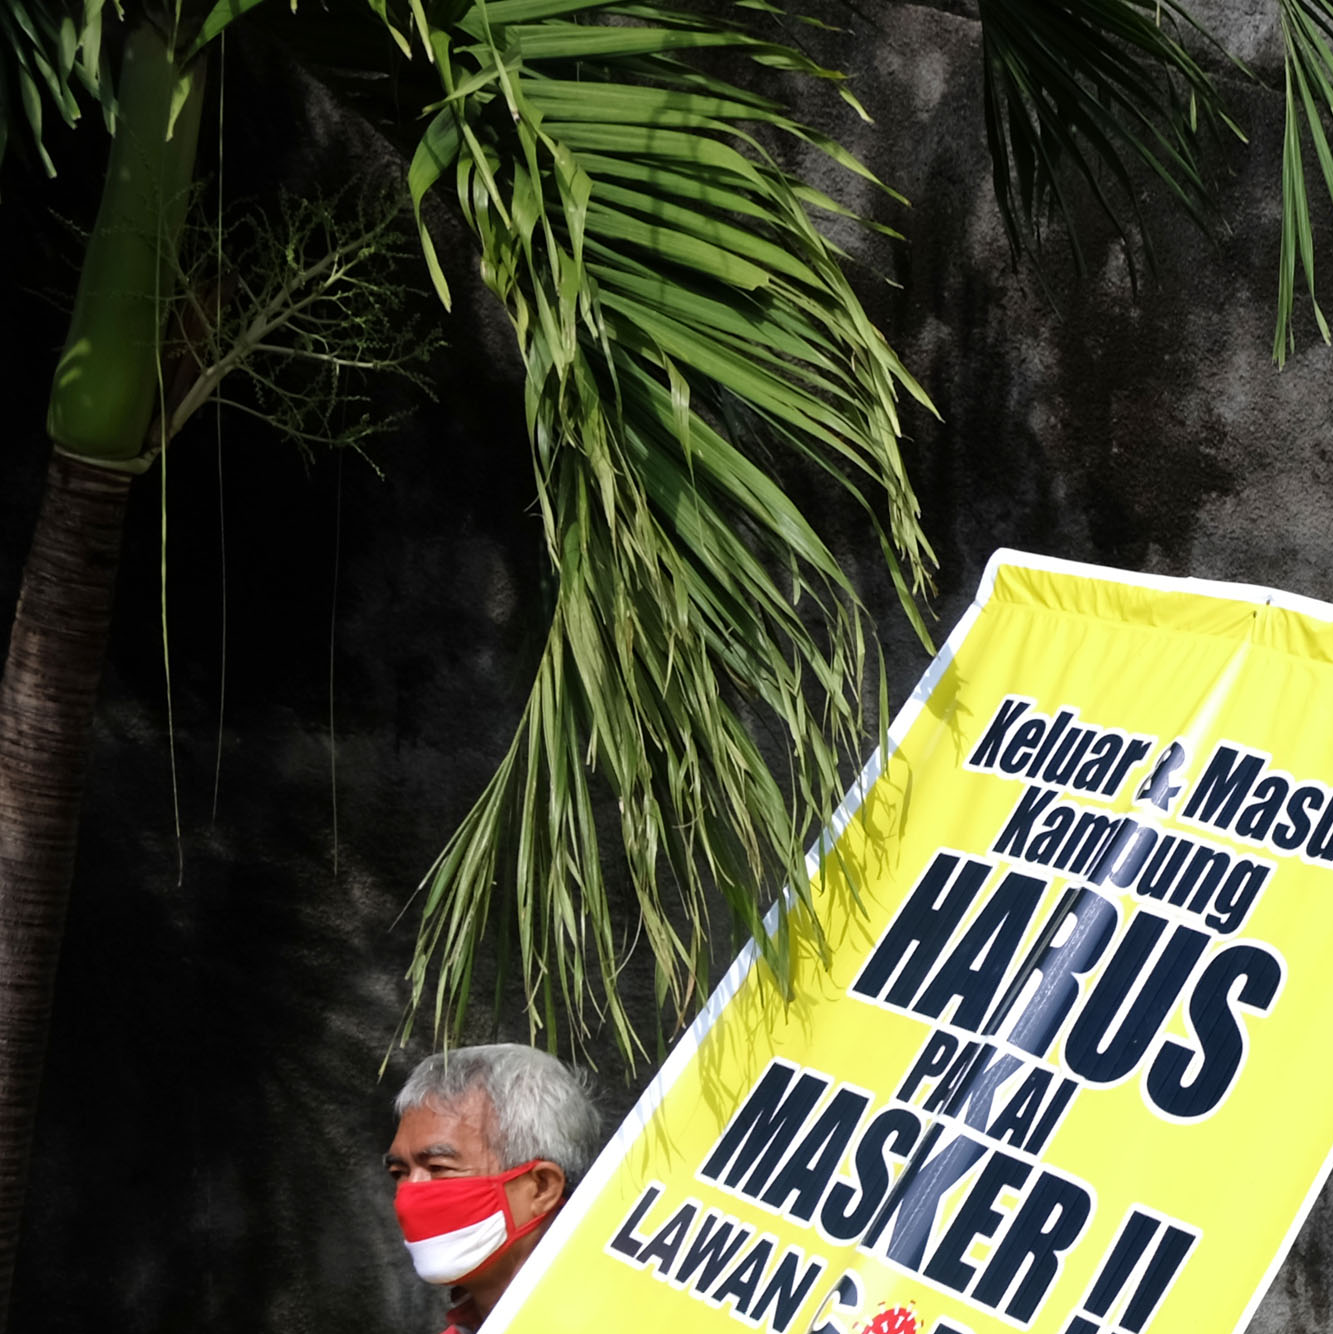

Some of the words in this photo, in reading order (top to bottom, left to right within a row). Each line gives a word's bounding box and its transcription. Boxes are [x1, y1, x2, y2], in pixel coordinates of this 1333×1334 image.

[969, 699, 1152, 796] Keluar
[1136, 741, 1185, 812] &
[993, 786, 1270, 934] Kampung
[852, 853, 1282, 1118] HARUS
[897, 1030, 1079, 1156] PAKAI
[610, 1187, 821, 1334] LAWAN
[700, 1061, 1091, 1324] MASKER
